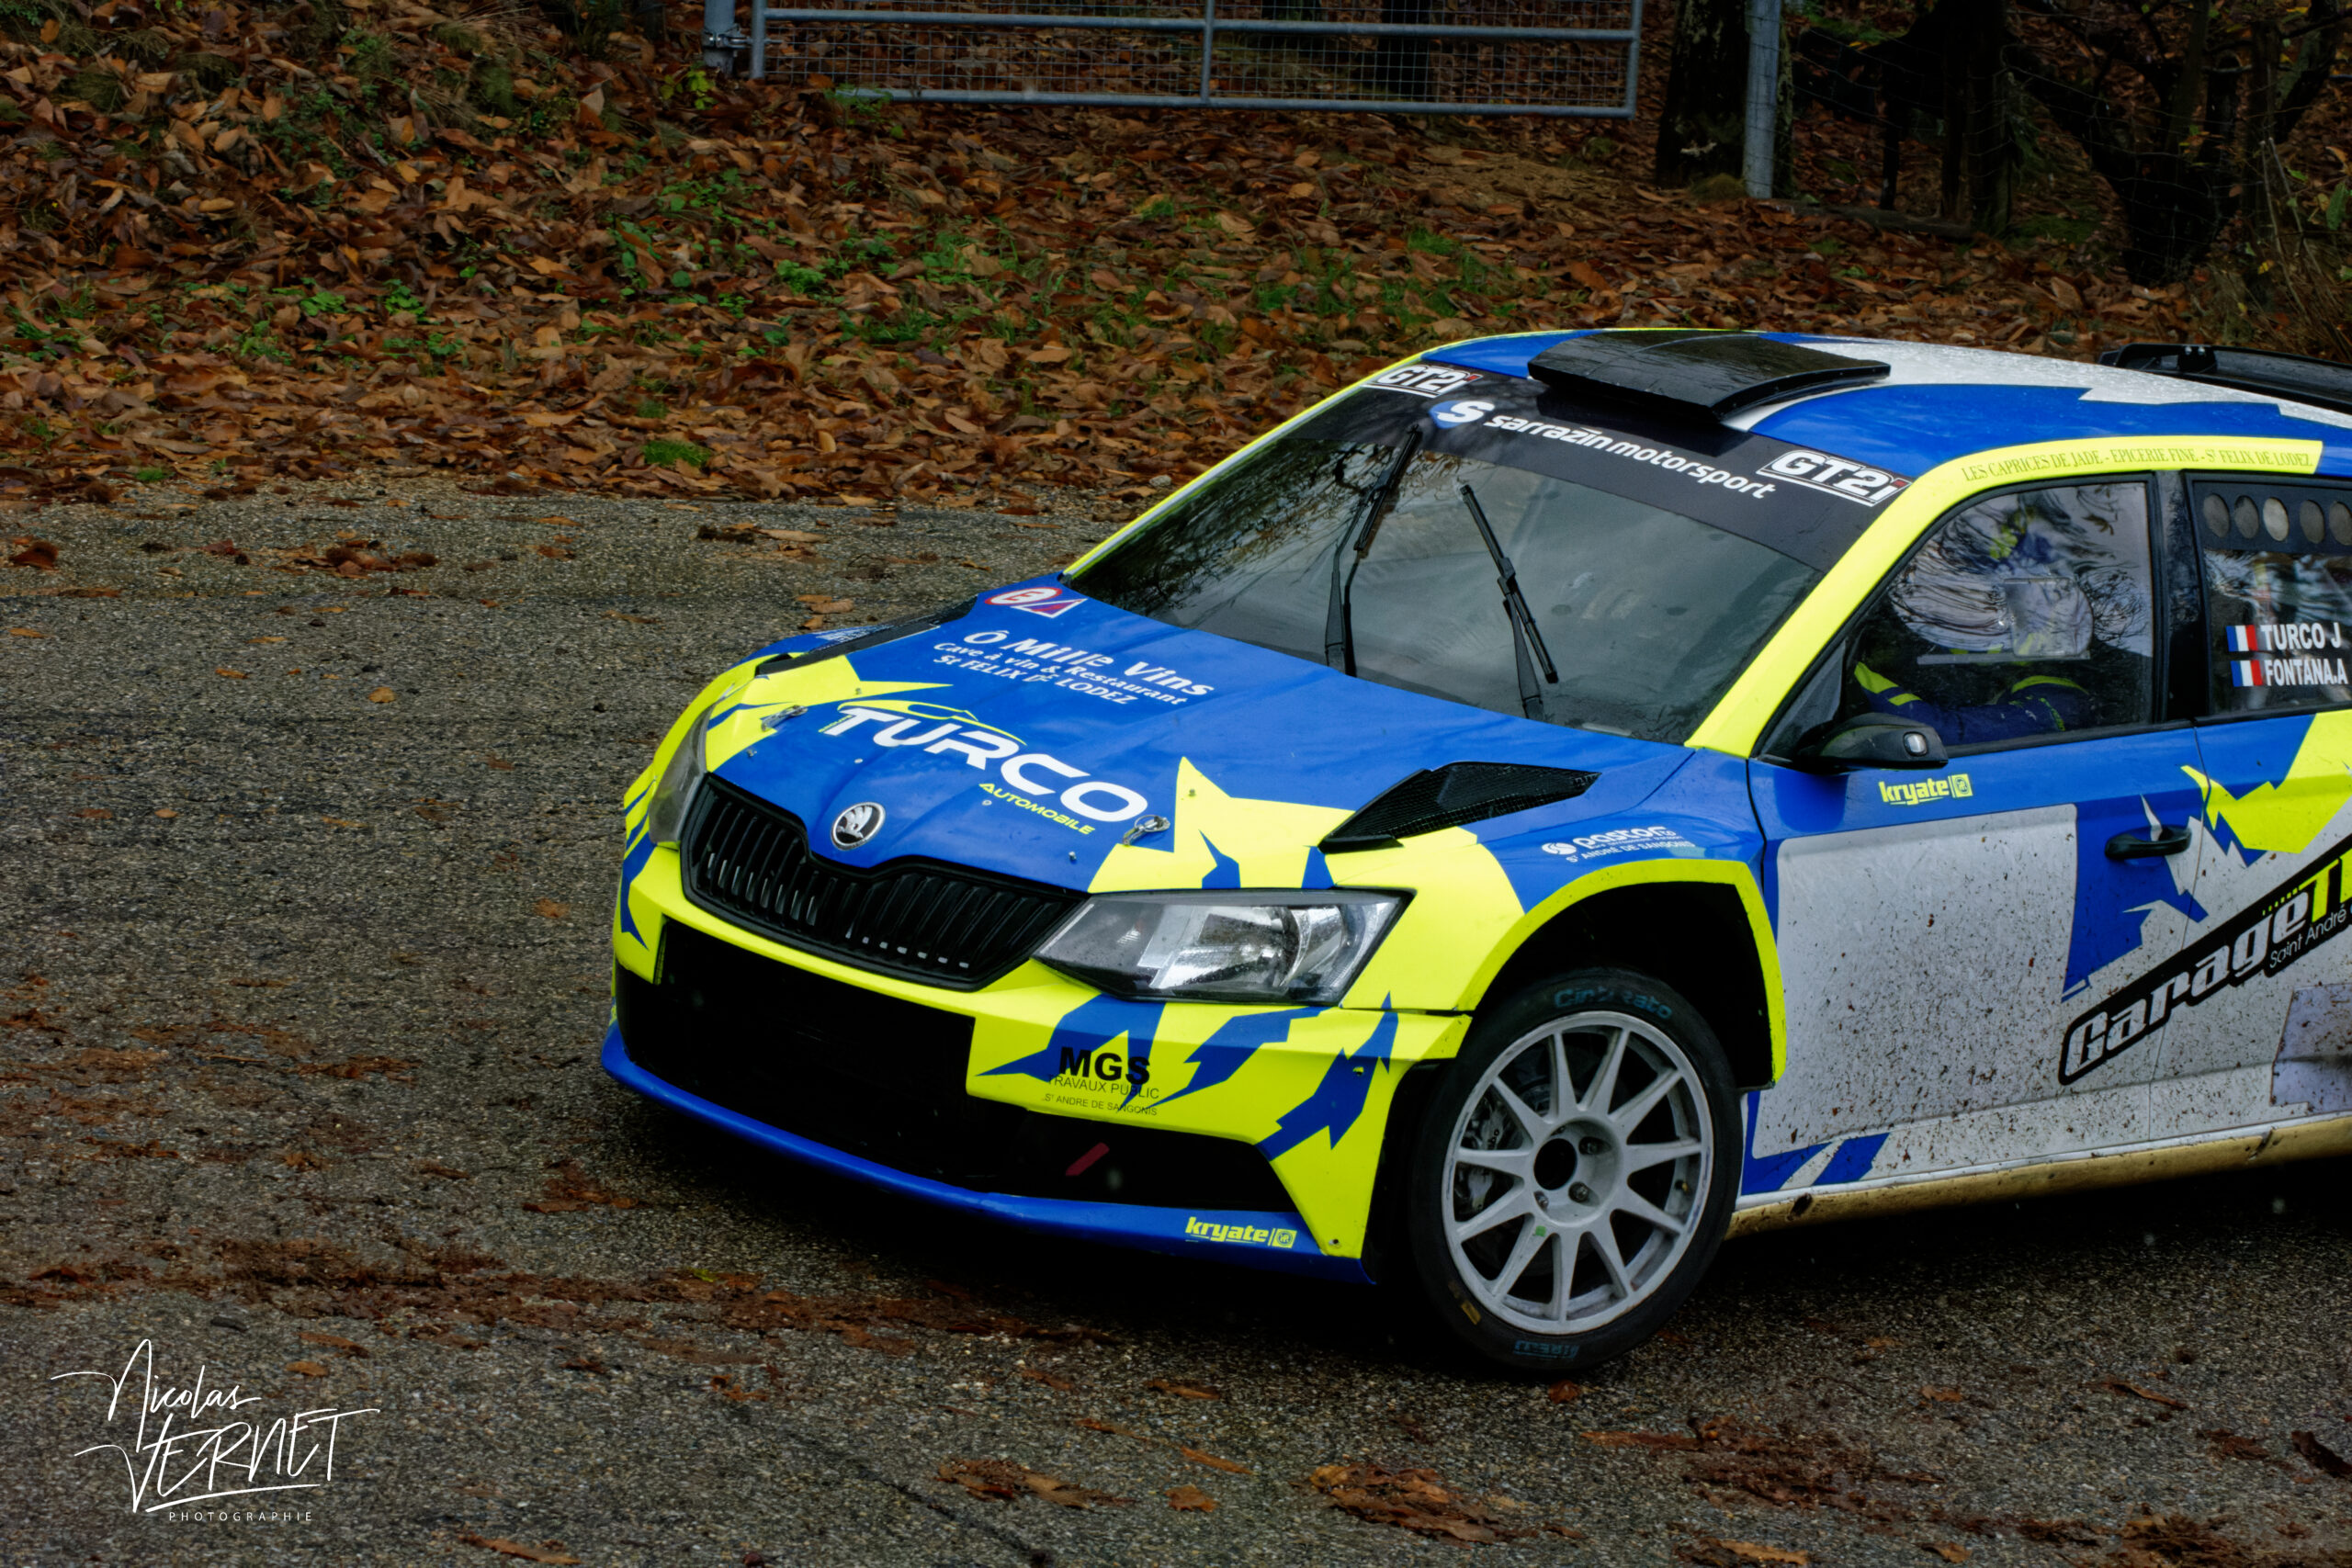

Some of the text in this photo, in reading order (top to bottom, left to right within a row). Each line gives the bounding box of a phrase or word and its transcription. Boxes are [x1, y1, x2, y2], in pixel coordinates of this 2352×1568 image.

[1483, 415, 1777, 499] sarrazin motorsport
[1962, 466, 1988, 482] LES
[1987, 454, 2051, 478] CAPRICES
[2050, 453, 2071, 468] DE
[2070, 450, 2103, 468] JADE
[2110, 447, 2169, 463] EPICERIE
[2168, 448, 2199, 462] FINE
[2216, 449, 2256, 464] FELIX
[2255, 451, 2275, 465] DE
[2260, 622, 2342, 651] TURCO J
[933, 642, 984, 657] Cave
[1004, 657, 1040, 670] vin
[1040, 665, 1061, 674] &
[1064, 666, 1188, 705] Restaurant
[933, 655, 962, 666] St
[960, 660, 1027, 680] FELIX
[1054, 679, 1139, 705] LODEZ
[1000, 638, 1114, 667] Mille
[1124, 661, 1215, 696] Vins
[822, 707, 1148, 822] TURCO
[978, 783, 1096, 836] AUTOMOBILE
[1878, 778, 1950, 806] kryate
[1572, 826, 1667, 850] pastor
[2269, 904, 2347, 969] Saint André
[1554, 987, 1672, 1021] Cinrato
[2064, 891, 2309, 1077] Garage
[1058, 1045, 1150, 1086] MGS
[1047, 1074, 1159, 1100] TRAVAUX PUBLIC
[1056, 1096, 1089, 1107] ANDRE
[1091, 1100, 1104, 1110] DE
[1107, 1101, 1158, 1116] SANGONIS
[1185, 1216, 1270, 1242] kryate
